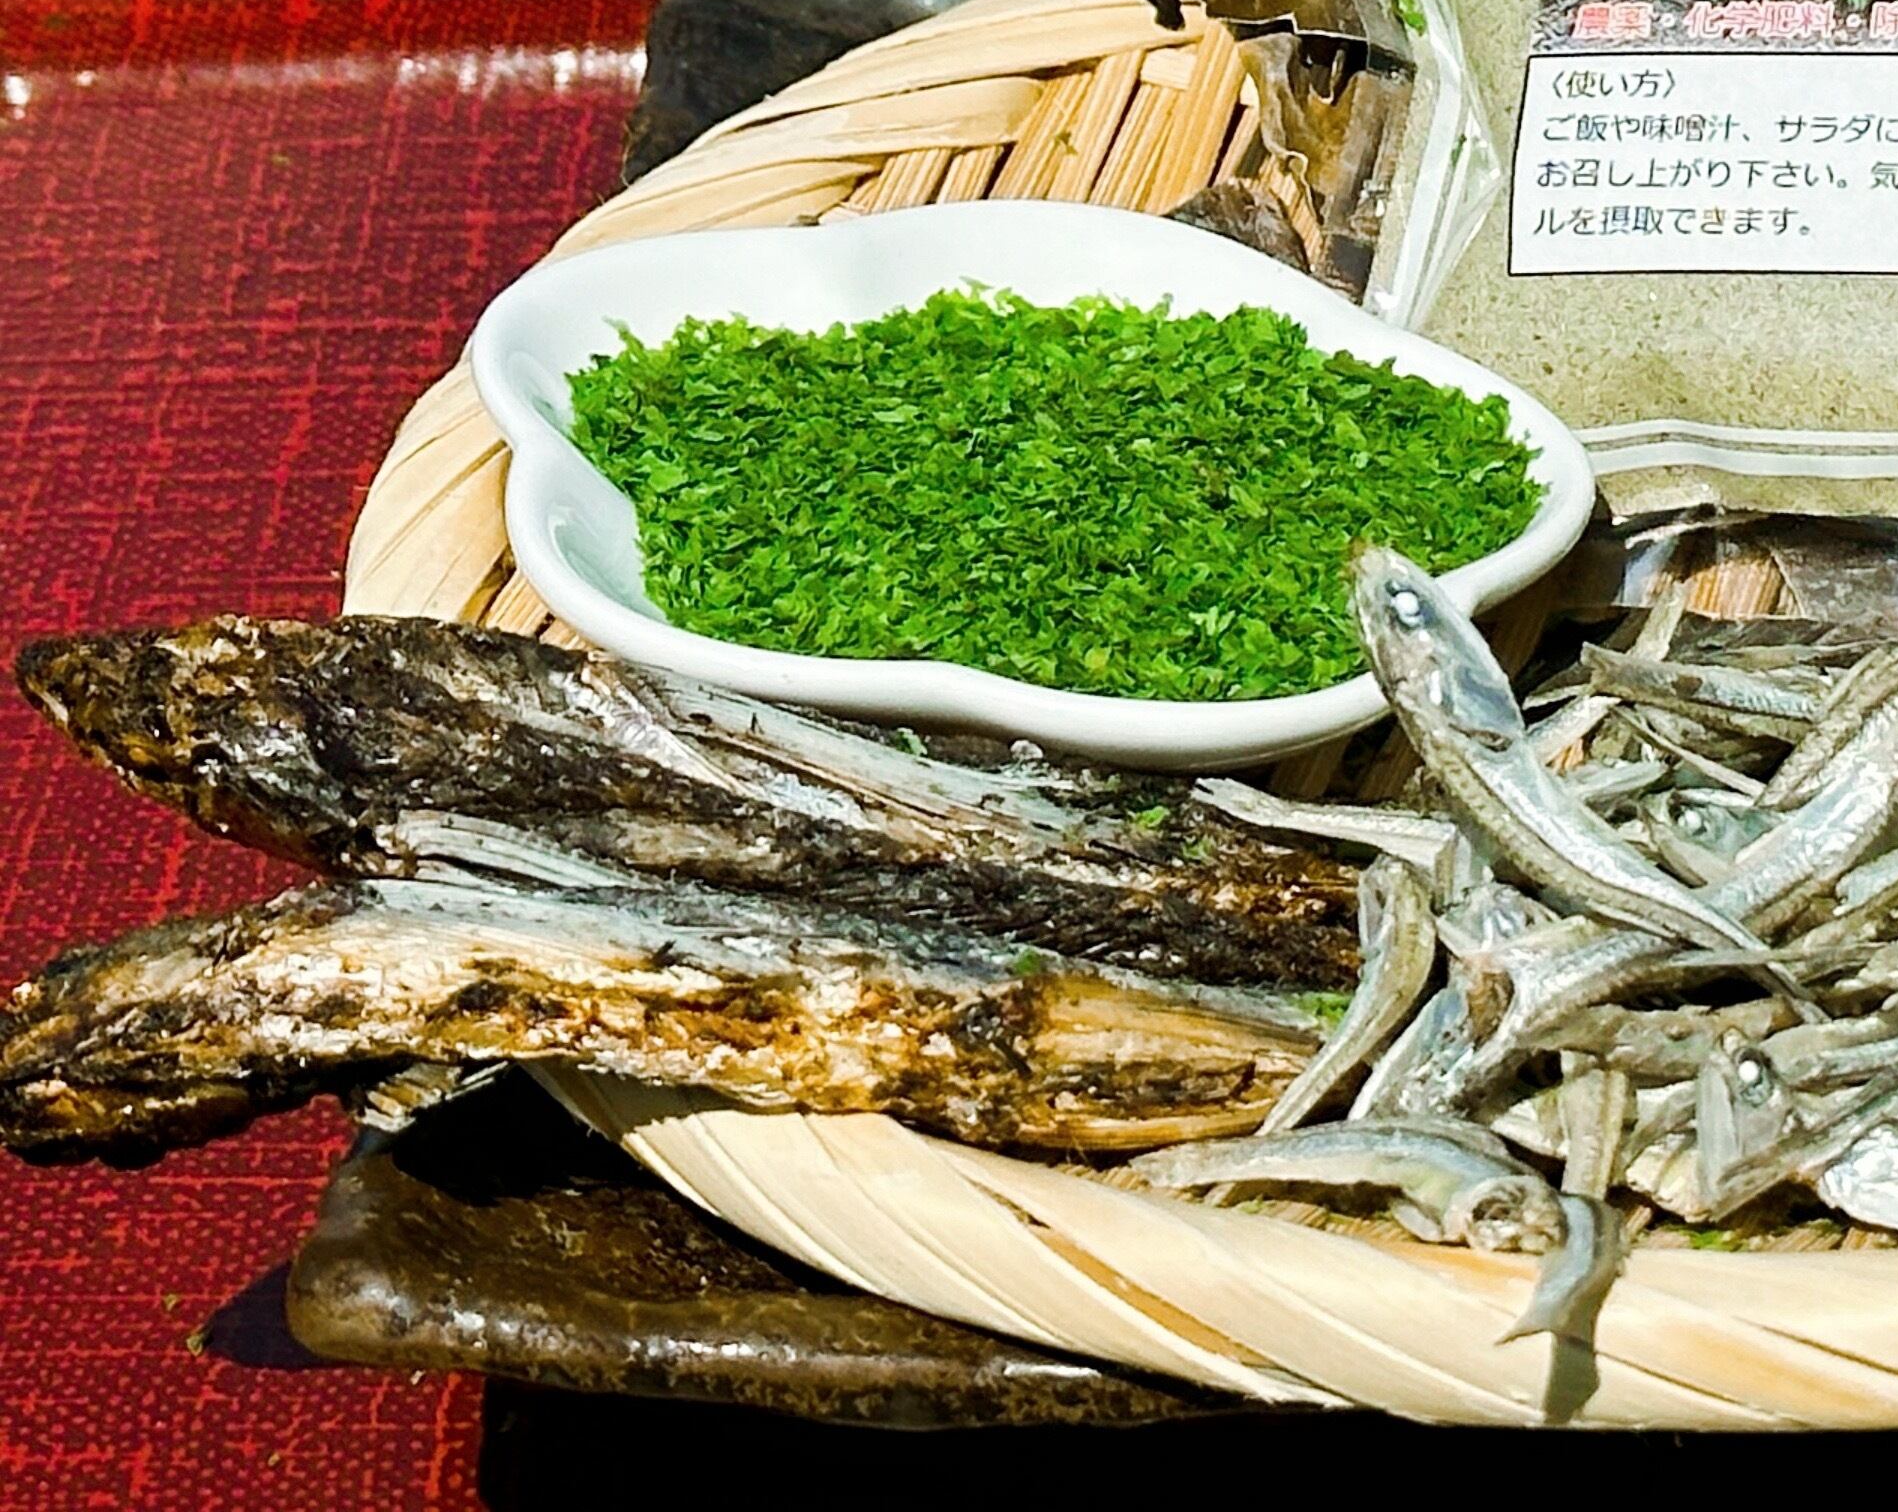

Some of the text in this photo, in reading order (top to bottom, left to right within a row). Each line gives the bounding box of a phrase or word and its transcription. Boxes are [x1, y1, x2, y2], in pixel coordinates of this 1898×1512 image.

[1533, 205, 1811, 236] ルを摂取できます。
